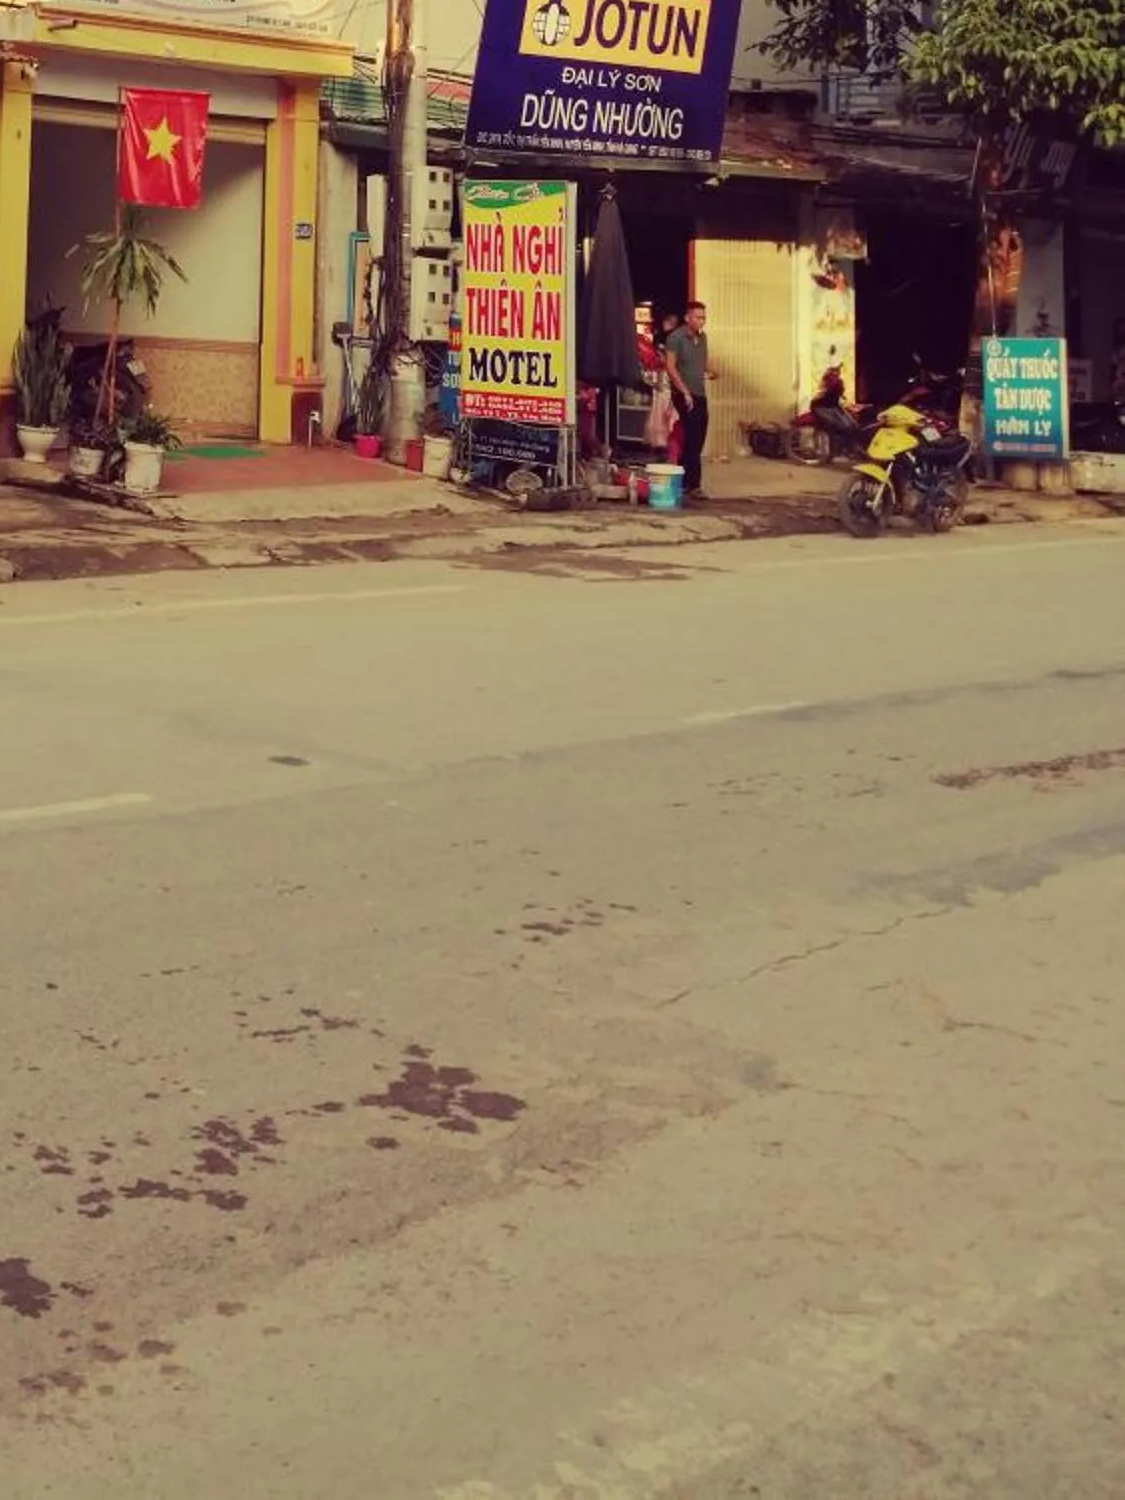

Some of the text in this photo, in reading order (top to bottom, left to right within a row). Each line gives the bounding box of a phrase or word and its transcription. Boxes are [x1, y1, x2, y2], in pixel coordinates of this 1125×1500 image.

[561, 66, 662, 92] ĐẠI LÝ SƠN
[520, 90, 684, 140] DŨNG NHƯỜNG
[467, 207, 564, 276] NHÀ NGHỈ
[466, 279, 561, 341] THIÊN ÂN
[468, 347, 558, 388] MOTEL
